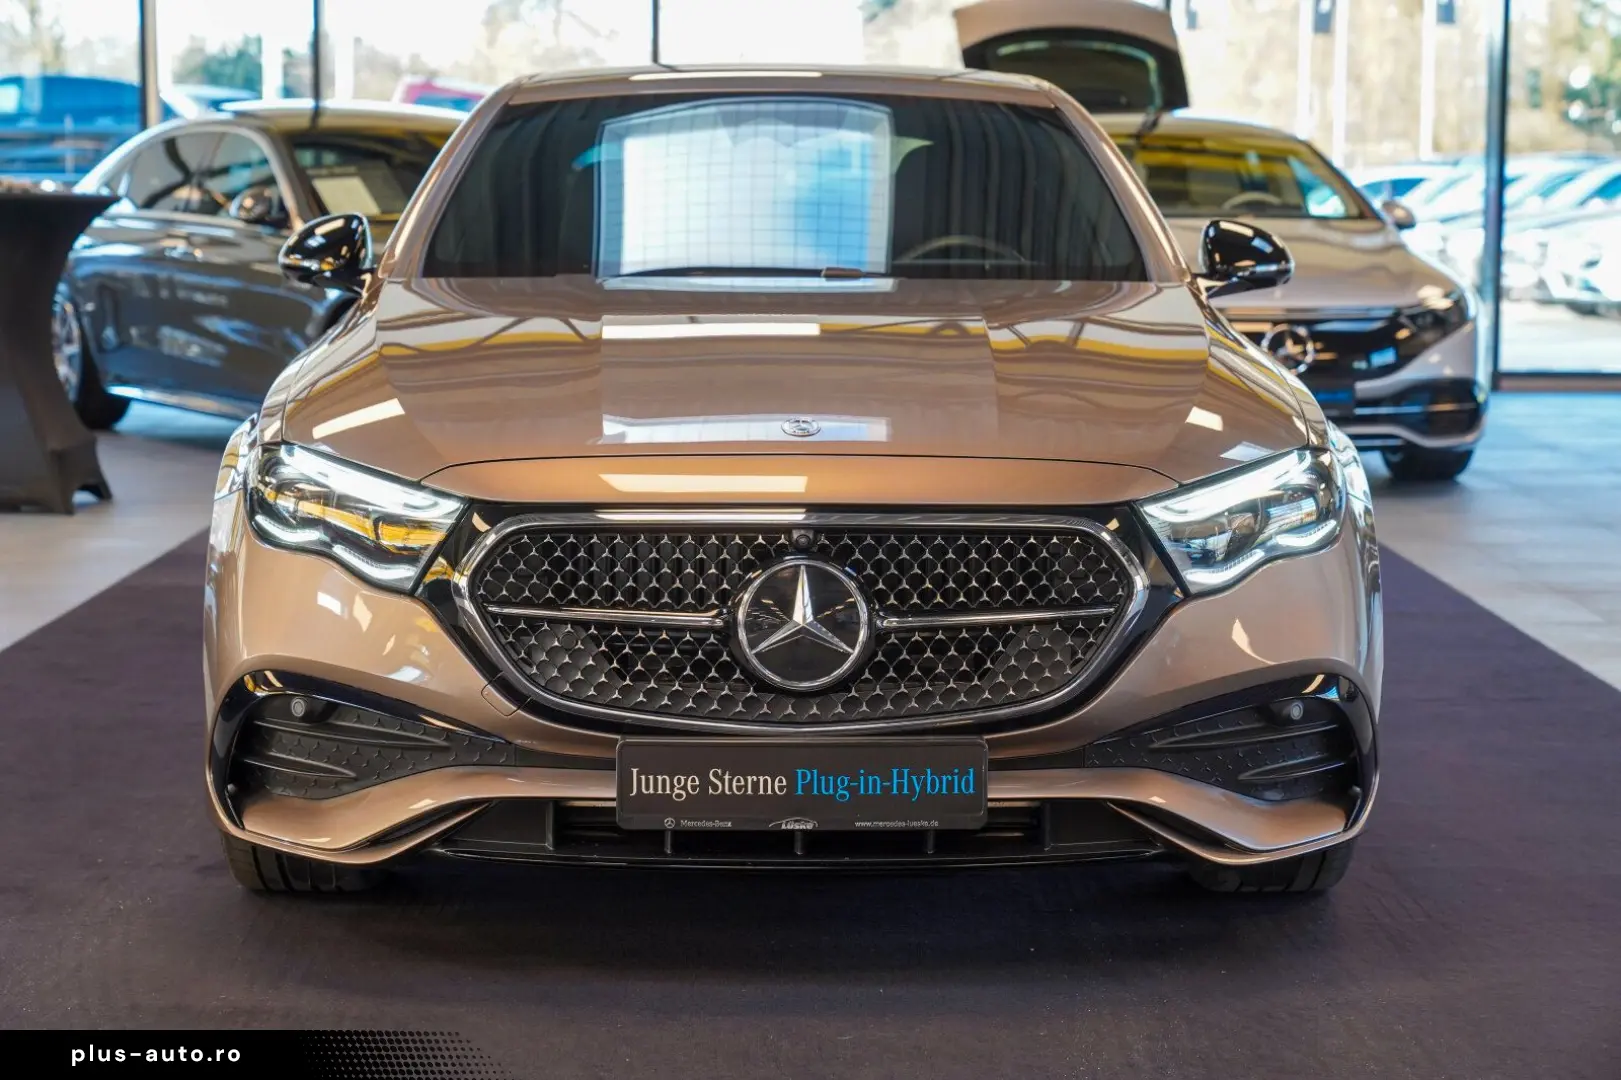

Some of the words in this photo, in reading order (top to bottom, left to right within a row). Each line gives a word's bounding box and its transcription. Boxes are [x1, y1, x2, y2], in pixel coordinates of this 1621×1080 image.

[630, 768, 700, 801] Junge
[708, 768, 787, 795] Sterne
[795, 768, 976, 802] Plug-in-Hybrid
[680, 819, 732, 828] Mercedes-Benz
